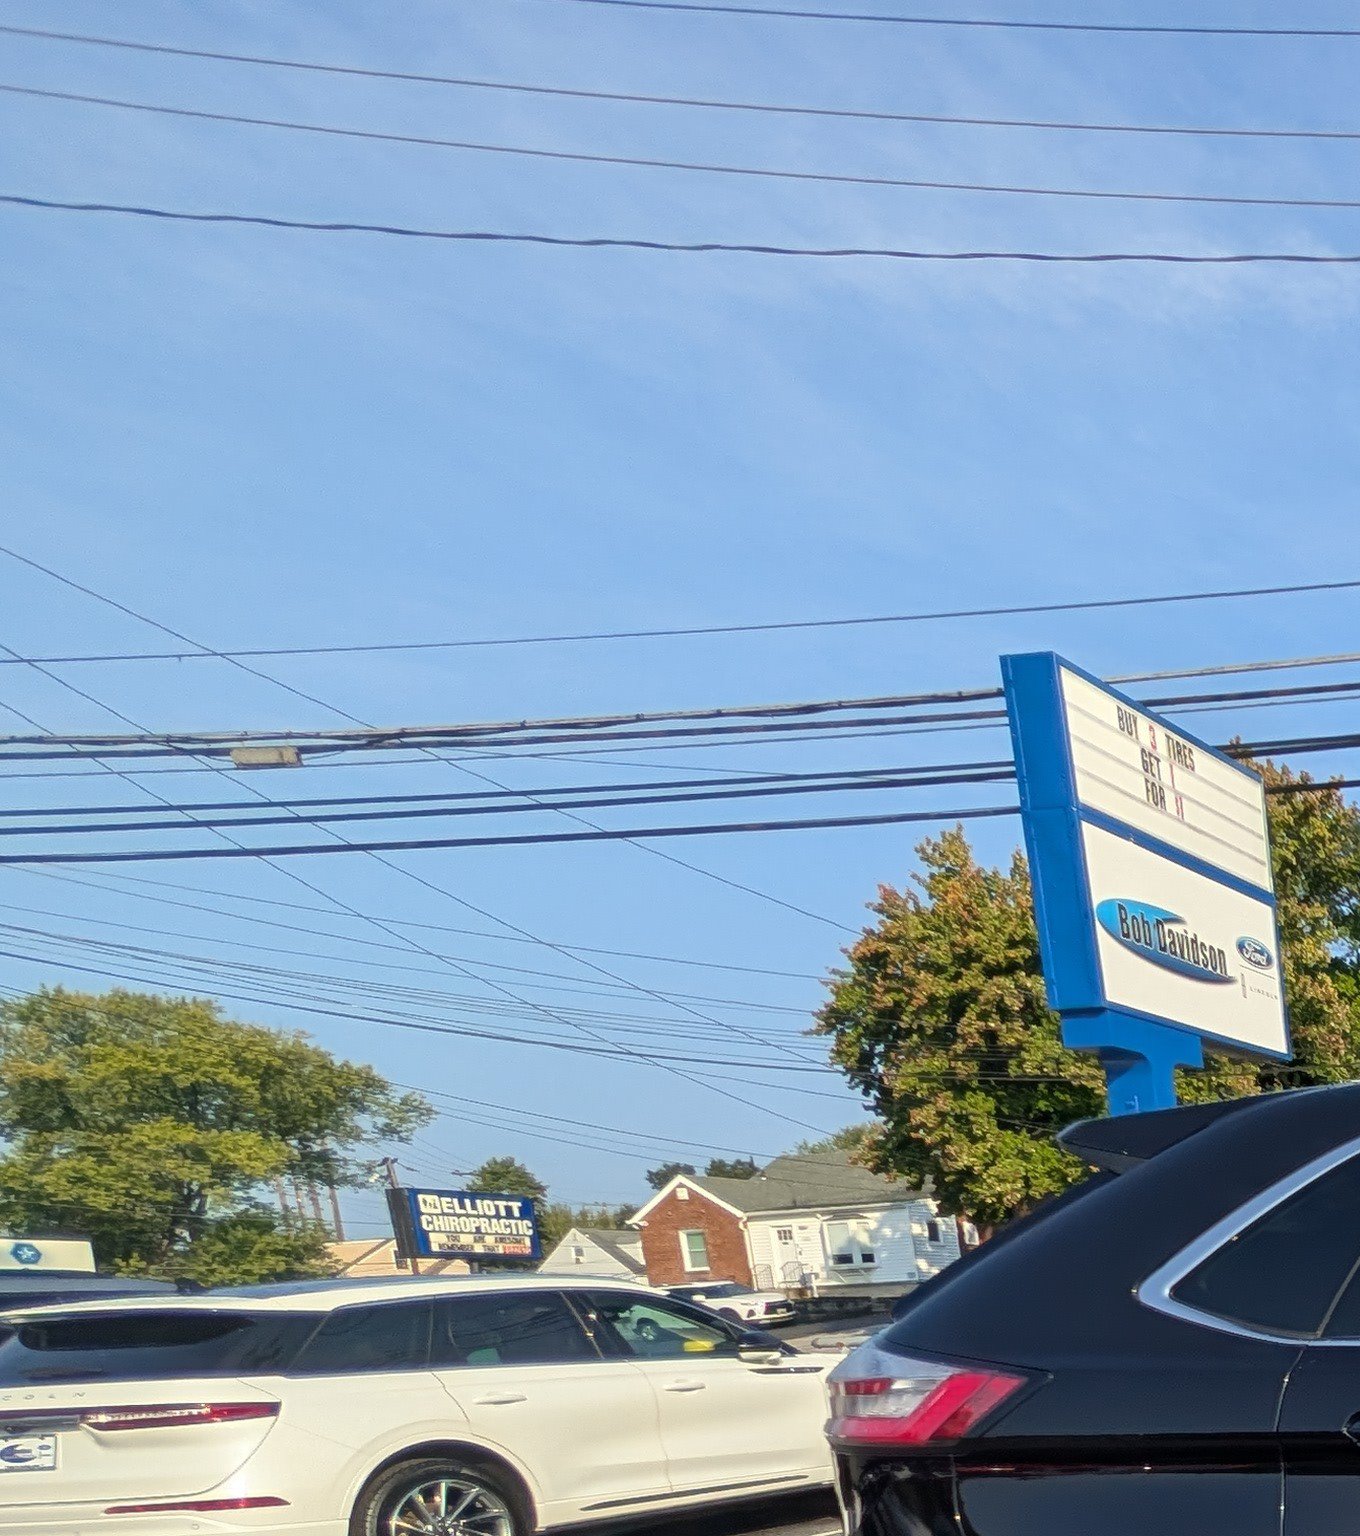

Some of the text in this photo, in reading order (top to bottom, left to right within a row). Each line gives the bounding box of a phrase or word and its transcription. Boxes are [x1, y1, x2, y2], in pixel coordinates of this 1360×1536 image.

[1116, 704, 1195, 772] BUY 3 TIRES
[1140, 747, 1161, 782] GET
[1144, 778, 1167, 811] FOR
[1117, 902, 1228, 976] Bob Davidson
[440, 1196, 522, 1217] ELLIOTT
[420, 1214, 534, 1236] CHIROPRACTIC
